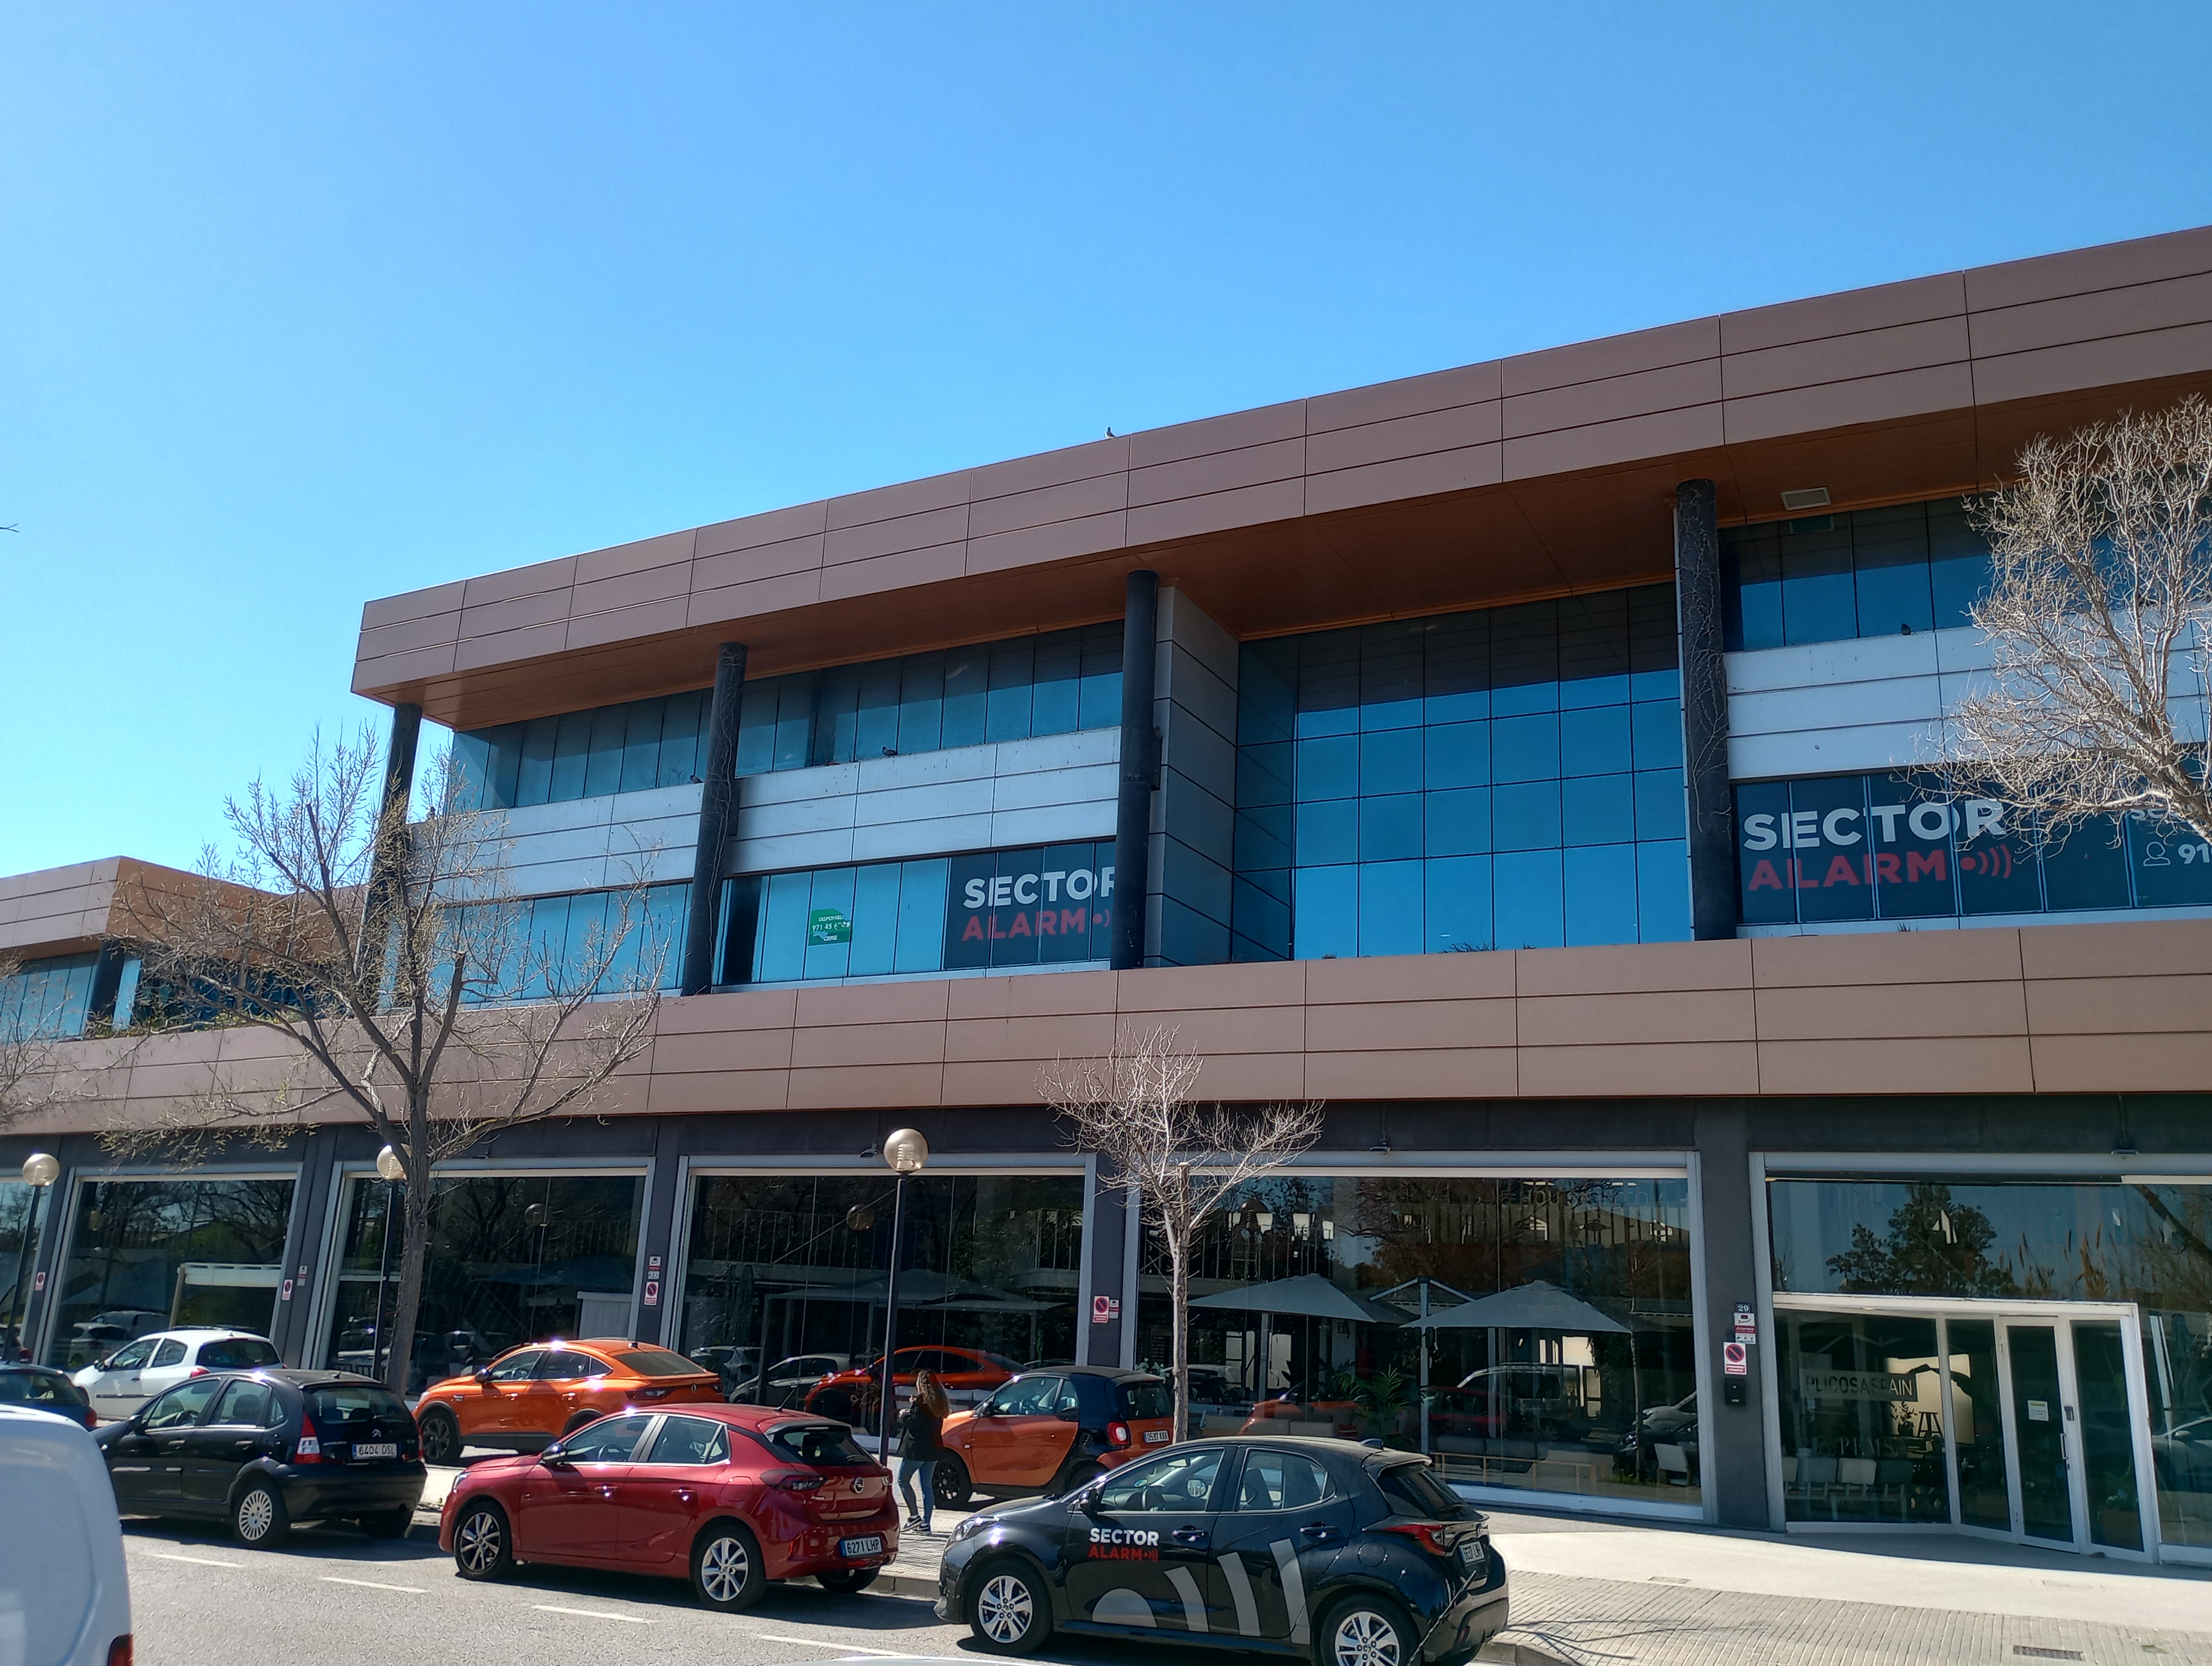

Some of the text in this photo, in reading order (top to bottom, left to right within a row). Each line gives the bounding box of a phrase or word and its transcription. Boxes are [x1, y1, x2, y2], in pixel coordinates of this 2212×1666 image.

[1743, 798, 2008, 850] SECTOR
[1747, 849, 1946, 890] ALARM
[961, 907, 1085, 941] ALARM
[358, 1445, 395, 1455] 6404 DSL
[1089, 1527, 1160, 1546] SECTOR
[847, 1539, 879, 1554] 6271 LHP
[1088, 1545, 1142, 1561] ALARM
